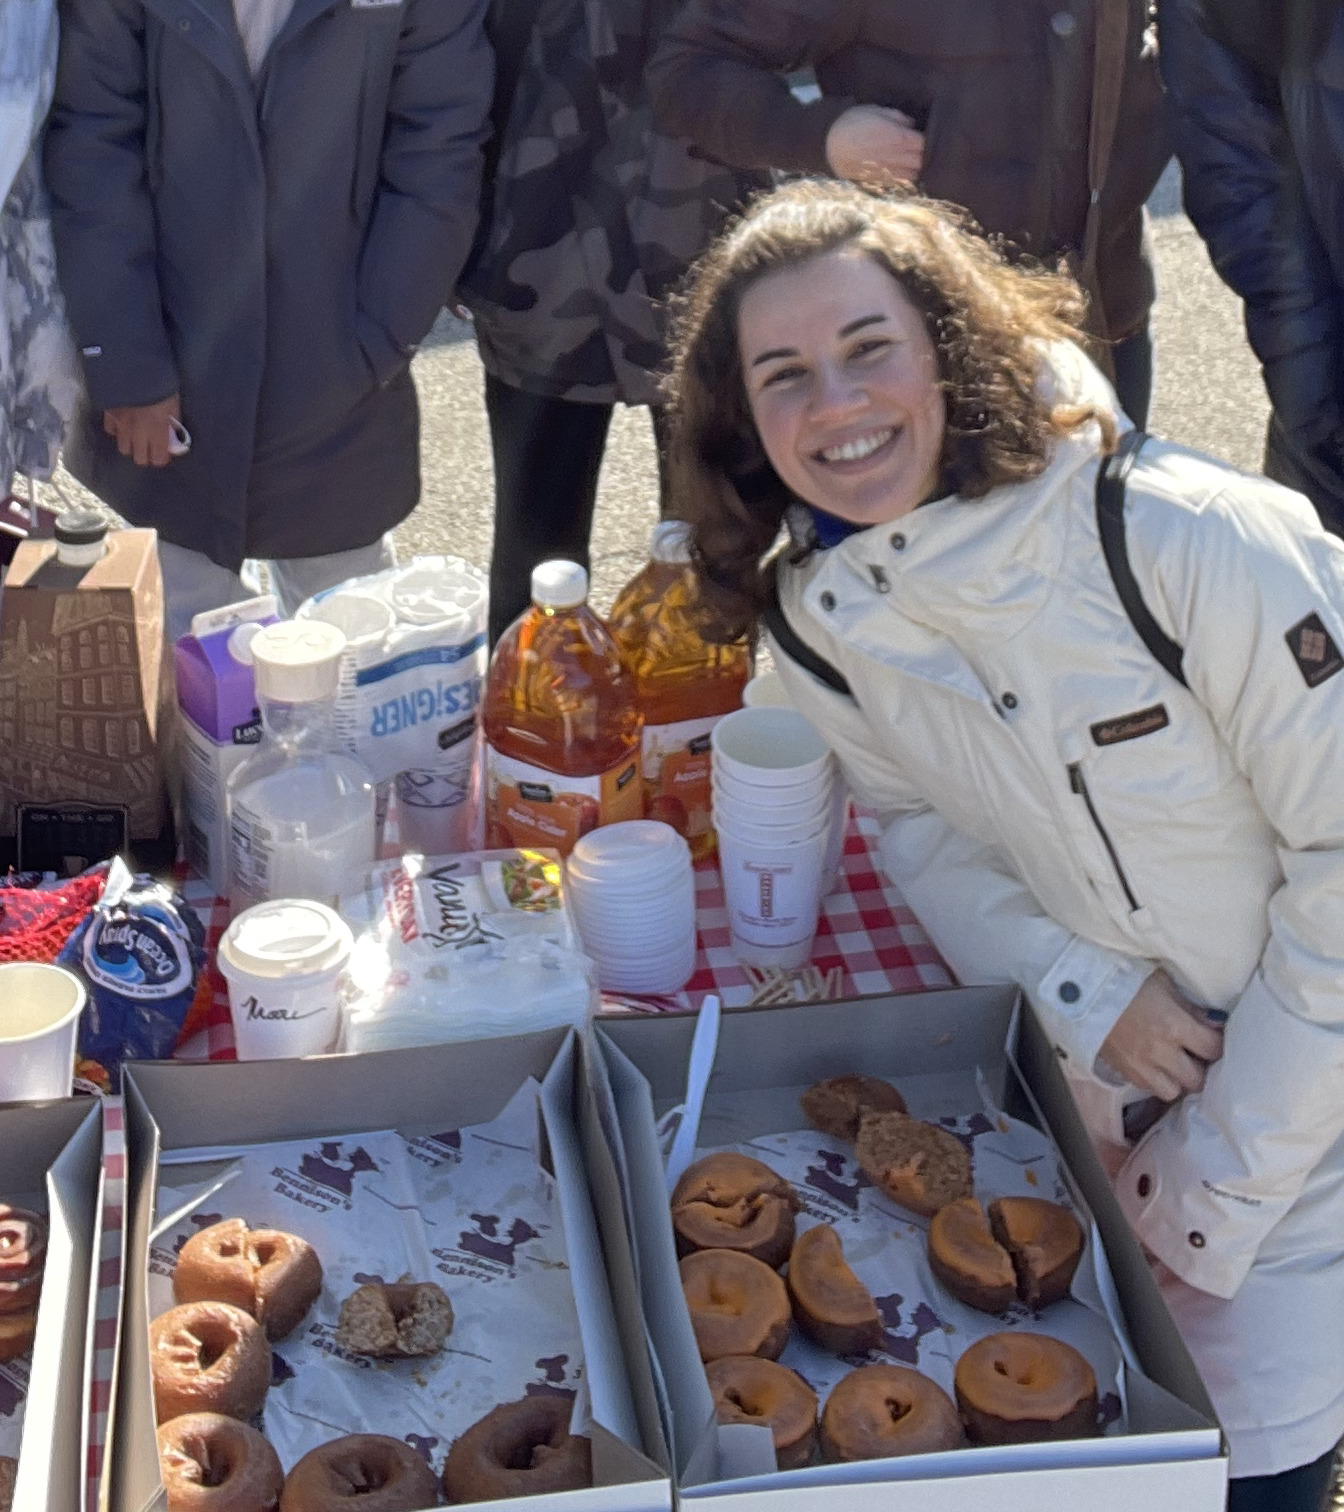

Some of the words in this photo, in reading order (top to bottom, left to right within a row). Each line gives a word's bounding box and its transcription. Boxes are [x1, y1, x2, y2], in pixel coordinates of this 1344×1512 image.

[98, 923, 139, 952] Spray
[135, 933, 175, 976] Ocean
[270, 1166, 354, 1211] Bennison's
[272, 1182, 330, 1214] Bakery
